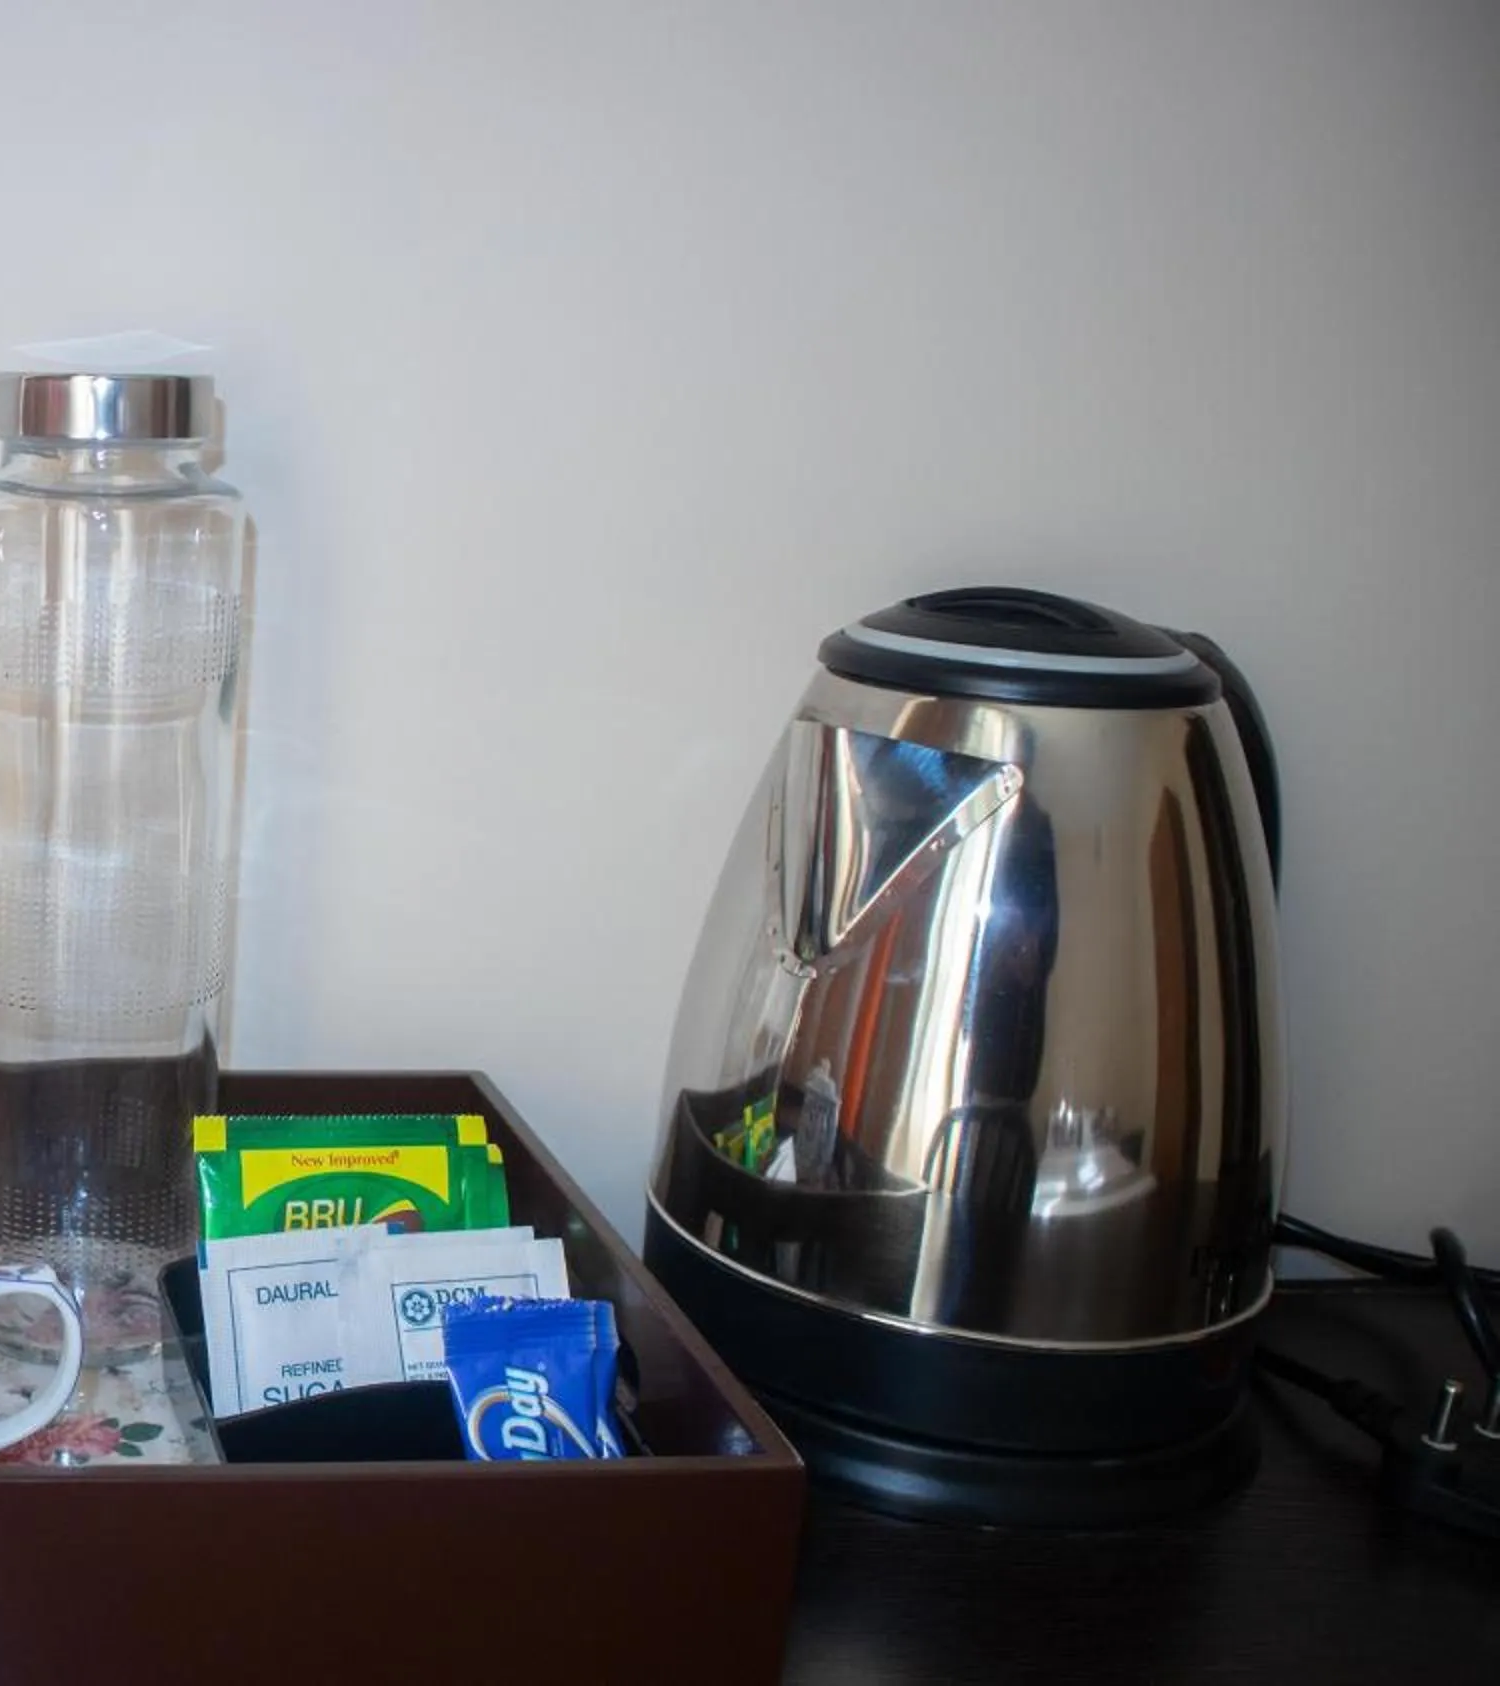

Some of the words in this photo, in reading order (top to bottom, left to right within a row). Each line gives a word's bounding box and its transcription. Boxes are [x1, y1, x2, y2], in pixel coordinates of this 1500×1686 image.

[291, 1153, 324, 1168] New
[284, 1196, 362, 1232] BRU
[501, 1366, 550, 1460] Day
